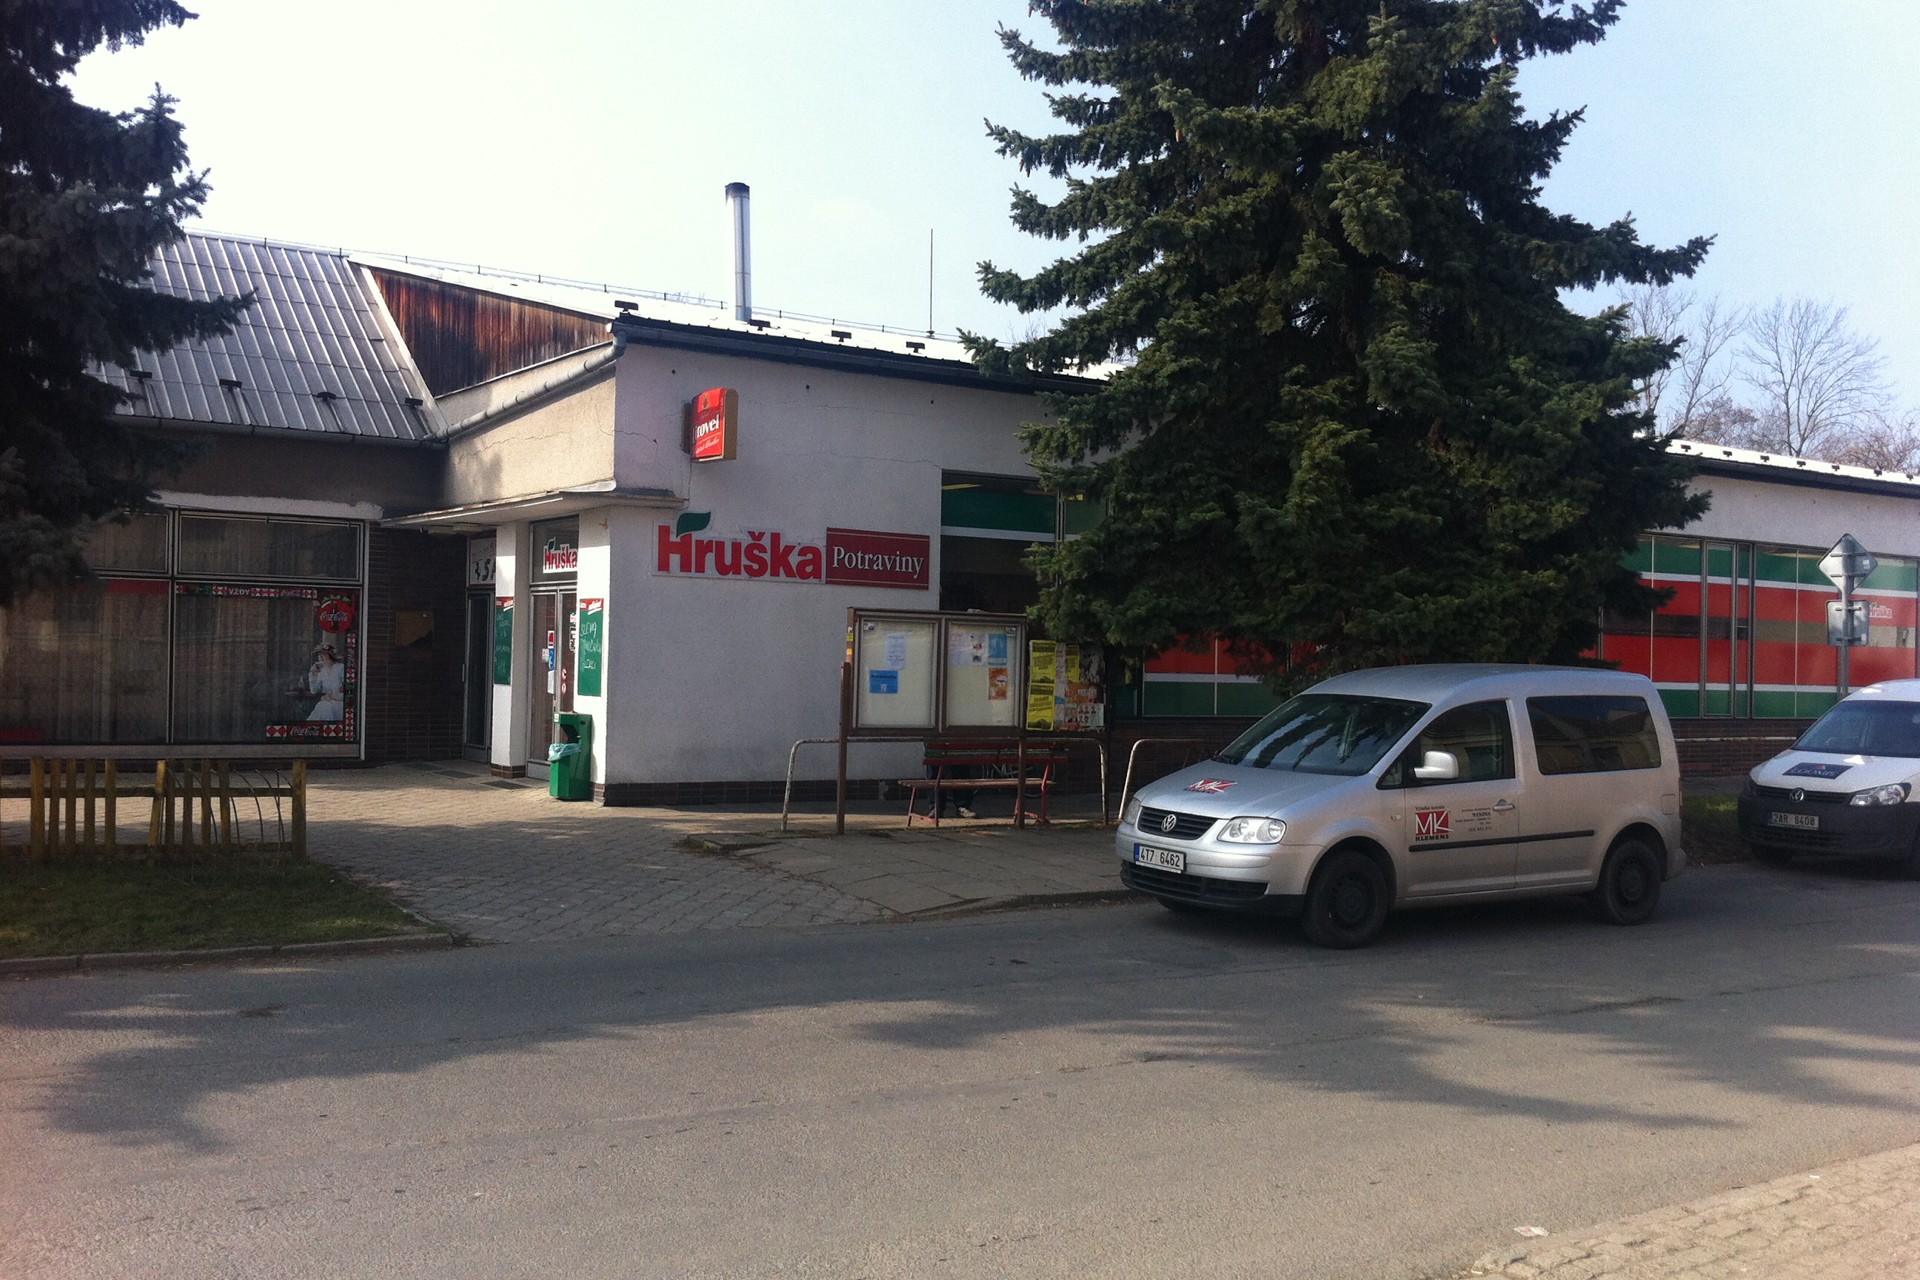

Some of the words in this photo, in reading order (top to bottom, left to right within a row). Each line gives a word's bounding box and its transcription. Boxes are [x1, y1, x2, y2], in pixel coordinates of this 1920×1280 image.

[544, 546, 577, 570] Hruška
[658, 525, 823, 580] Hruška
[832, 546, 925, 580] Potraviny
[1415, 810, 1454, 836] MK
[1140, 848, 1155, 862] 4T7
[1159, 851, 1180, 868] 6462
